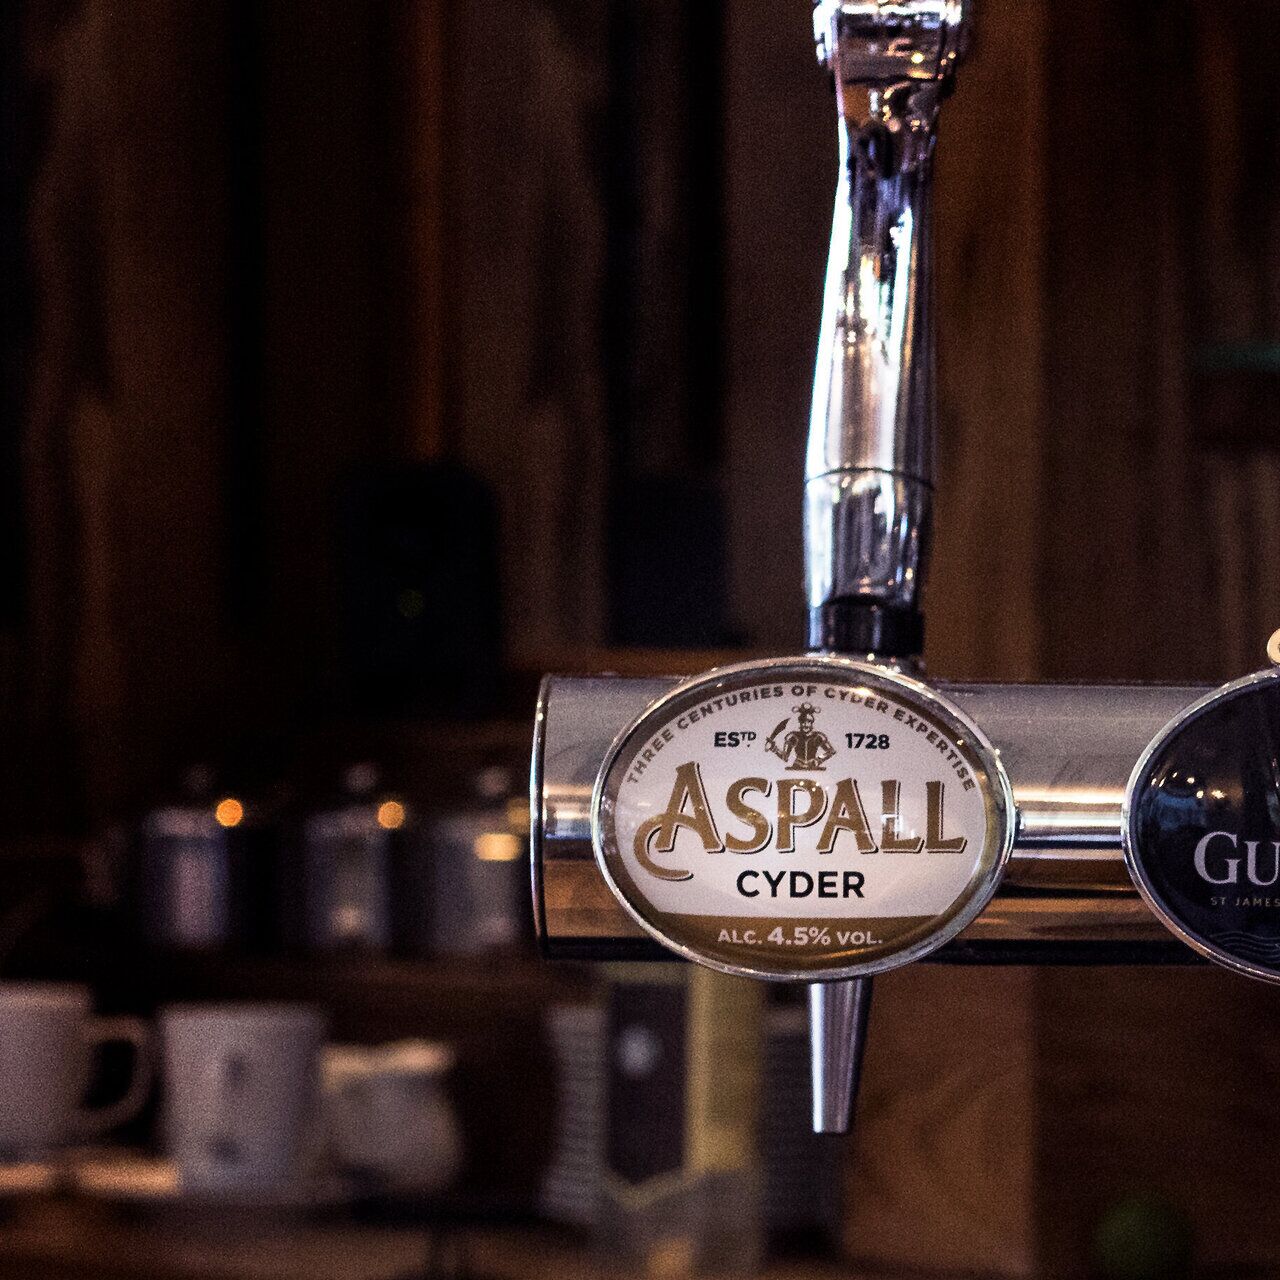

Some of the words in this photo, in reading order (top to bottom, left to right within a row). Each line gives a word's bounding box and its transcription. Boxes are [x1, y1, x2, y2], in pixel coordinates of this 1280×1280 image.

[627, 727, 675, 784] THREE
[677, 686, 784, 730] CENTURIES
[791, 685, 818, 698] OF
[824, 686, 888, 713] CYDER
[893, 709, 976, 792] EXPERTISE
[845, 733, 890, 750] 1728
[634, 761, 968, 881] ASPALL
[736, 871, 865, 898] CYDER
[1210, 897, 1226, 906] ST
[717, 929, 762, 945] ALC.
[767, 928, 831, 945] 4.5%
[836, 930, 882, 945] VOL.
